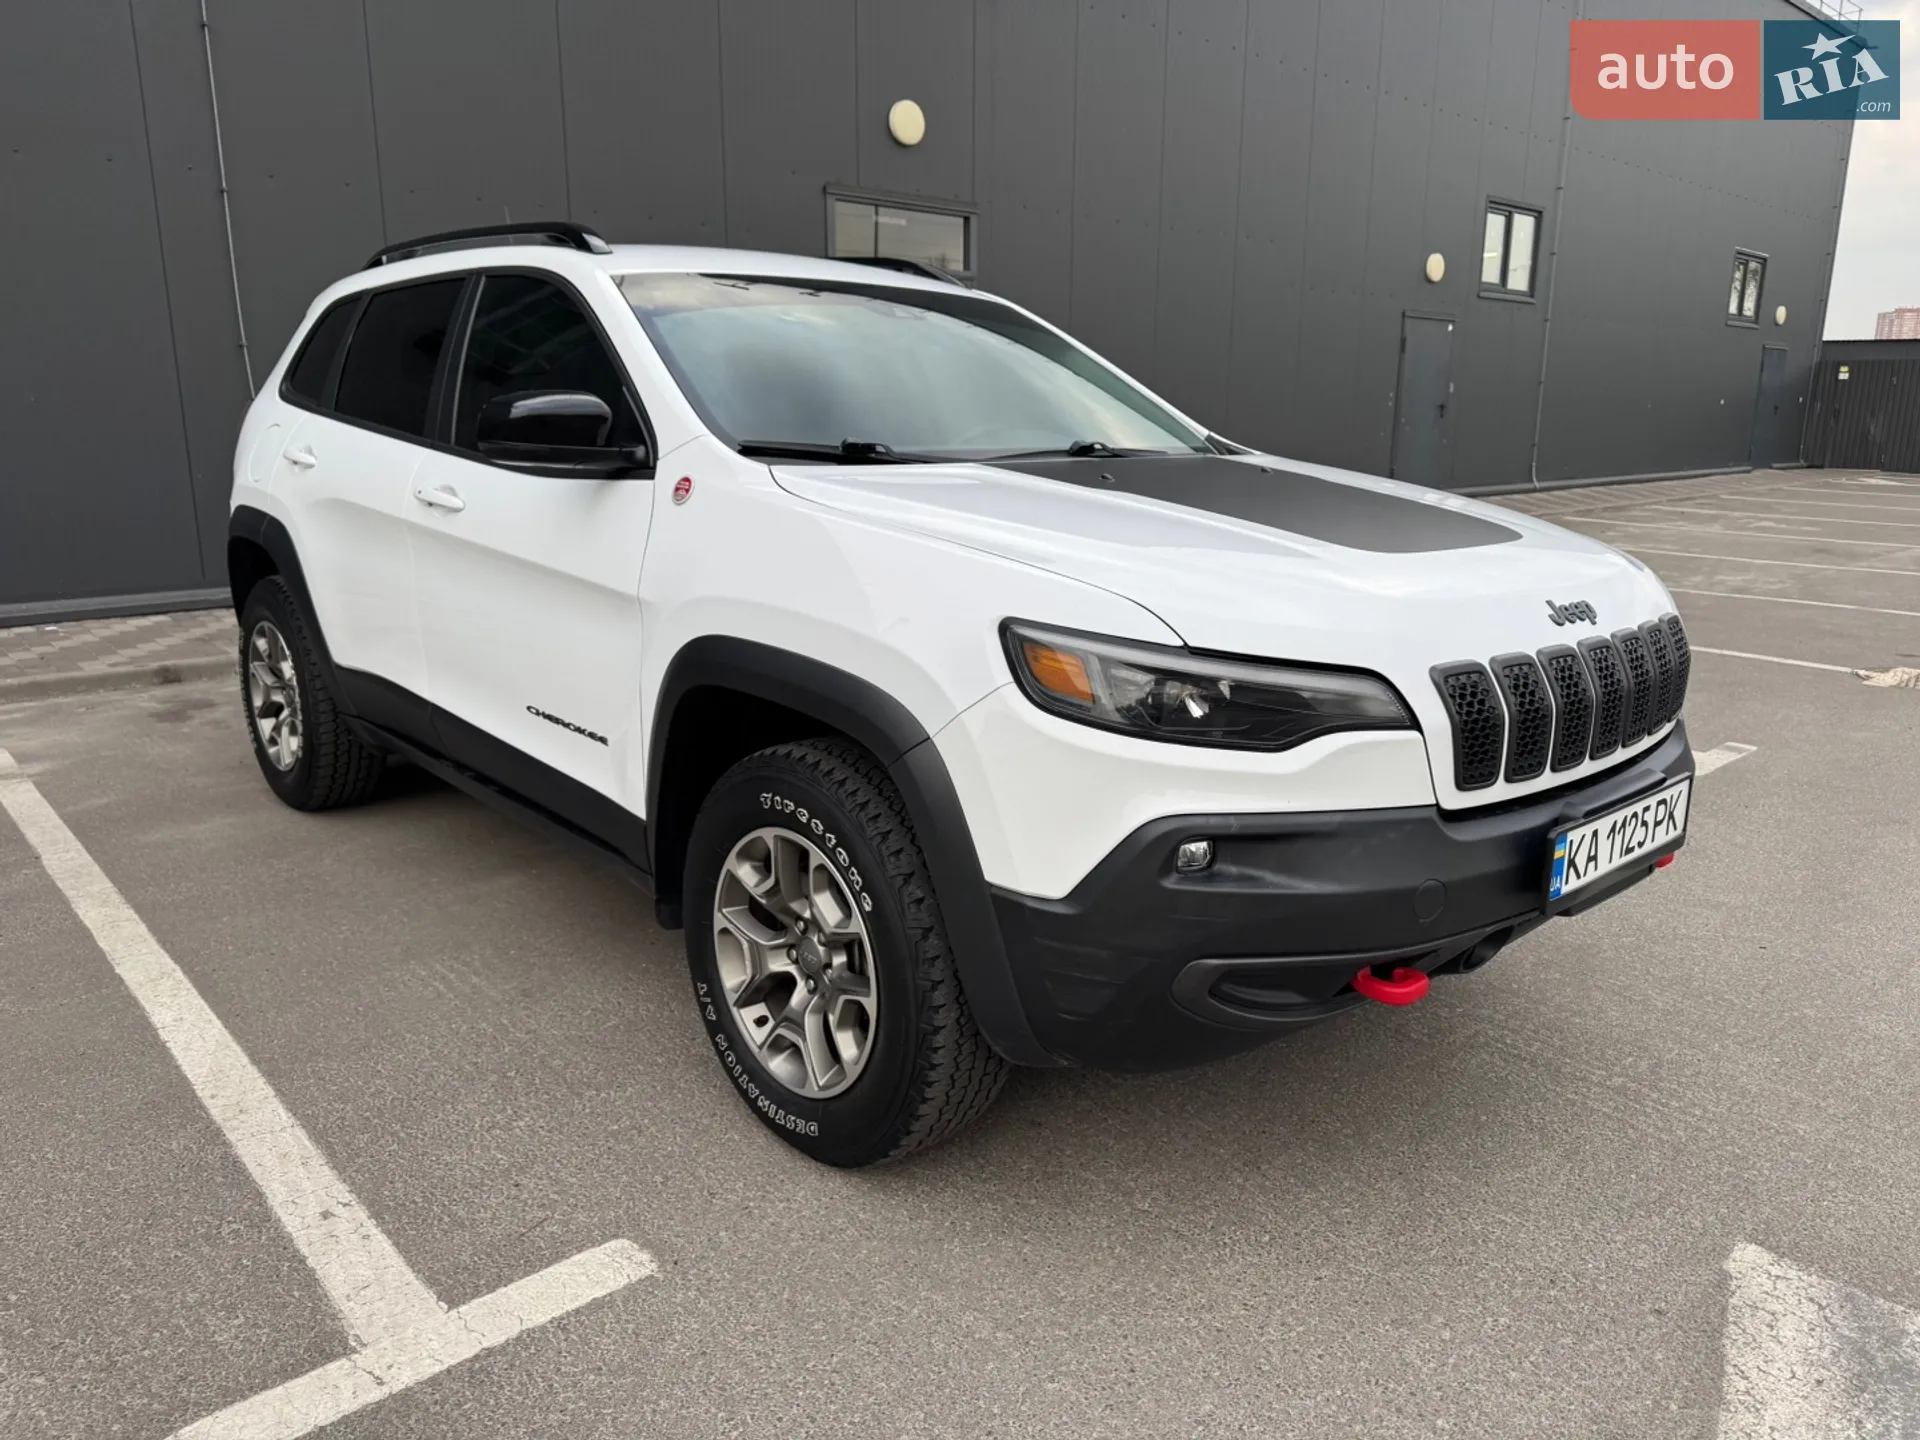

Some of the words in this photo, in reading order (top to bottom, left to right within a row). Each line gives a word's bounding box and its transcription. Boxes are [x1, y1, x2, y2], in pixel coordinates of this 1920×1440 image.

[1546, 599, 1598, 627] Jeep
[526, 705, 609, 747] CHEROKEE
[1565, 828, 1600, 886] KA
[1606, 804, 1652, 864] 1125
[1650, 789, 1683, 844] PK
[714, 1033, 819, 1137] DESTINATION
